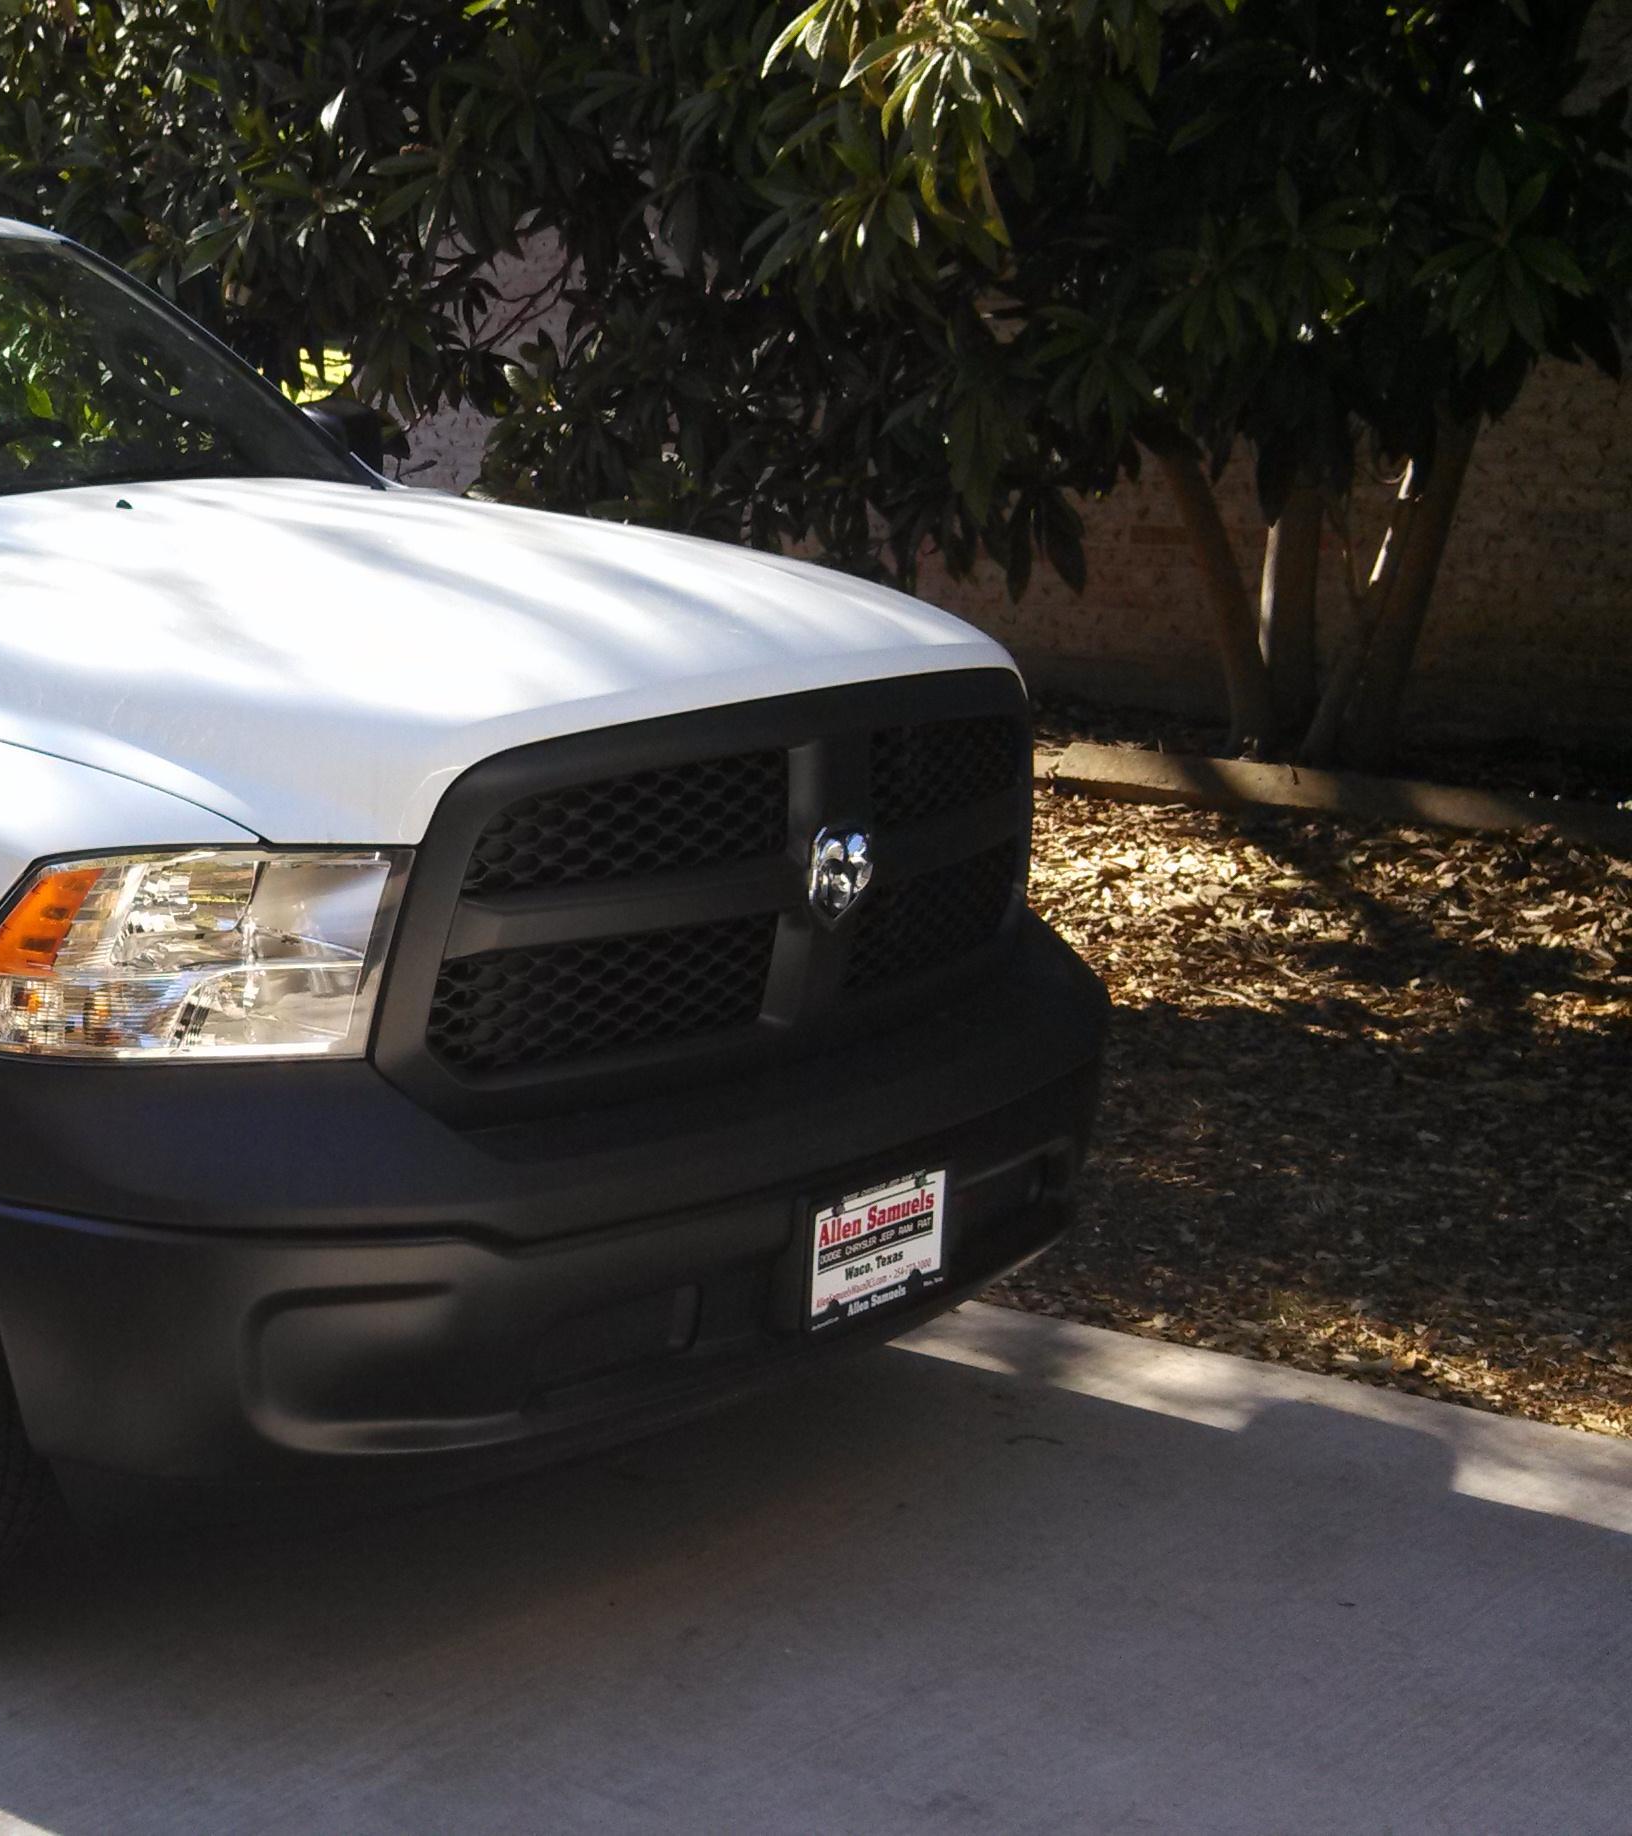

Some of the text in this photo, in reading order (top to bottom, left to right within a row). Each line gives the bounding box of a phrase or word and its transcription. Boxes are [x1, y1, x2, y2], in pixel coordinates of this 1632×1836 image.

[818, 1188, 935, 1248] Allen Samuels
[819, 1216, 932, 1265] DODGE CHRYSLER JEEP RAM FIAT
[844, 1250, 904, 1281] Waco, Texas
[847, 1284, 907, 1317] Allen Samuels
